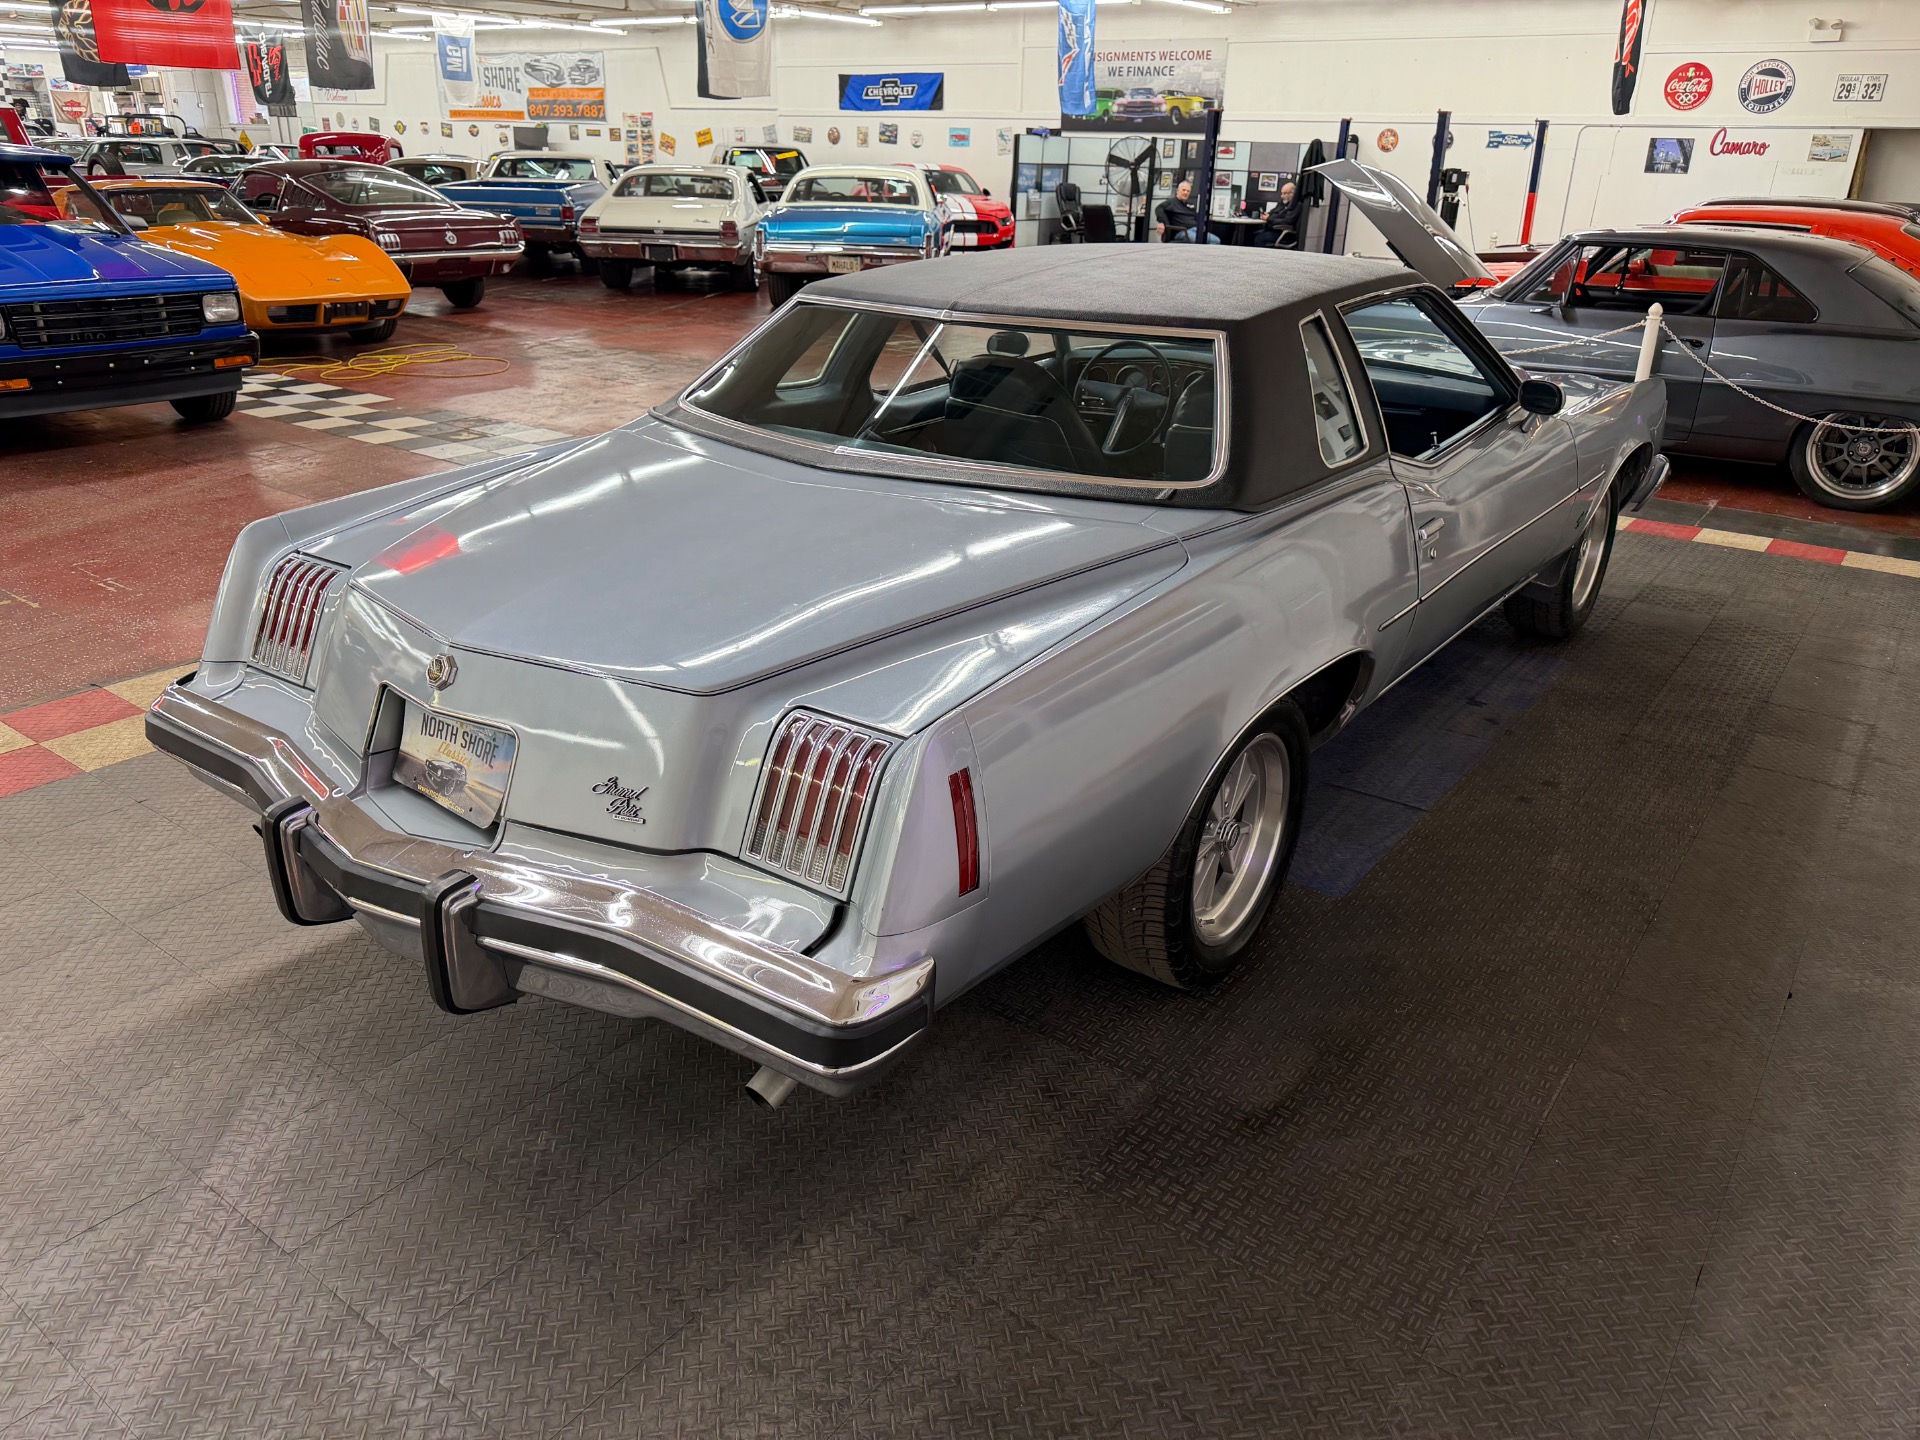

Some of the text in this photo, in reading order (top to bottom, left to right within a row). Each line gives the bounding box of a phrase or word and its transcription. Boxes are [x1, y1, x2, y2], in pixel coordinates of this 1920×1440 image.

[311, 0, 332, 71] dillac
[1094, 50, 1212, 62] SIGNMENTS WELCOME
[483, 66, 522, 94] SHORE
[1108, 65, 1176, 77] WE FINANCE
[1757, 63, 1792, 83] PERFORMANCE
[867, 86, 913, 97] CHEVROLET
[1753, 79, 1784, 96] HOLLEY
[529, 103, 605, 119] 847.393.7887
[1744, 98, 1784, 112] EQUIPPED
[1709, 127, 1770, 156] Camaro
[420, 712, 499, 769] NORTH SHORE
[437, 741, 474, 769] Classics
[591, 775, 650, 801] Grand
[604, 796, 642, 817] Prix
